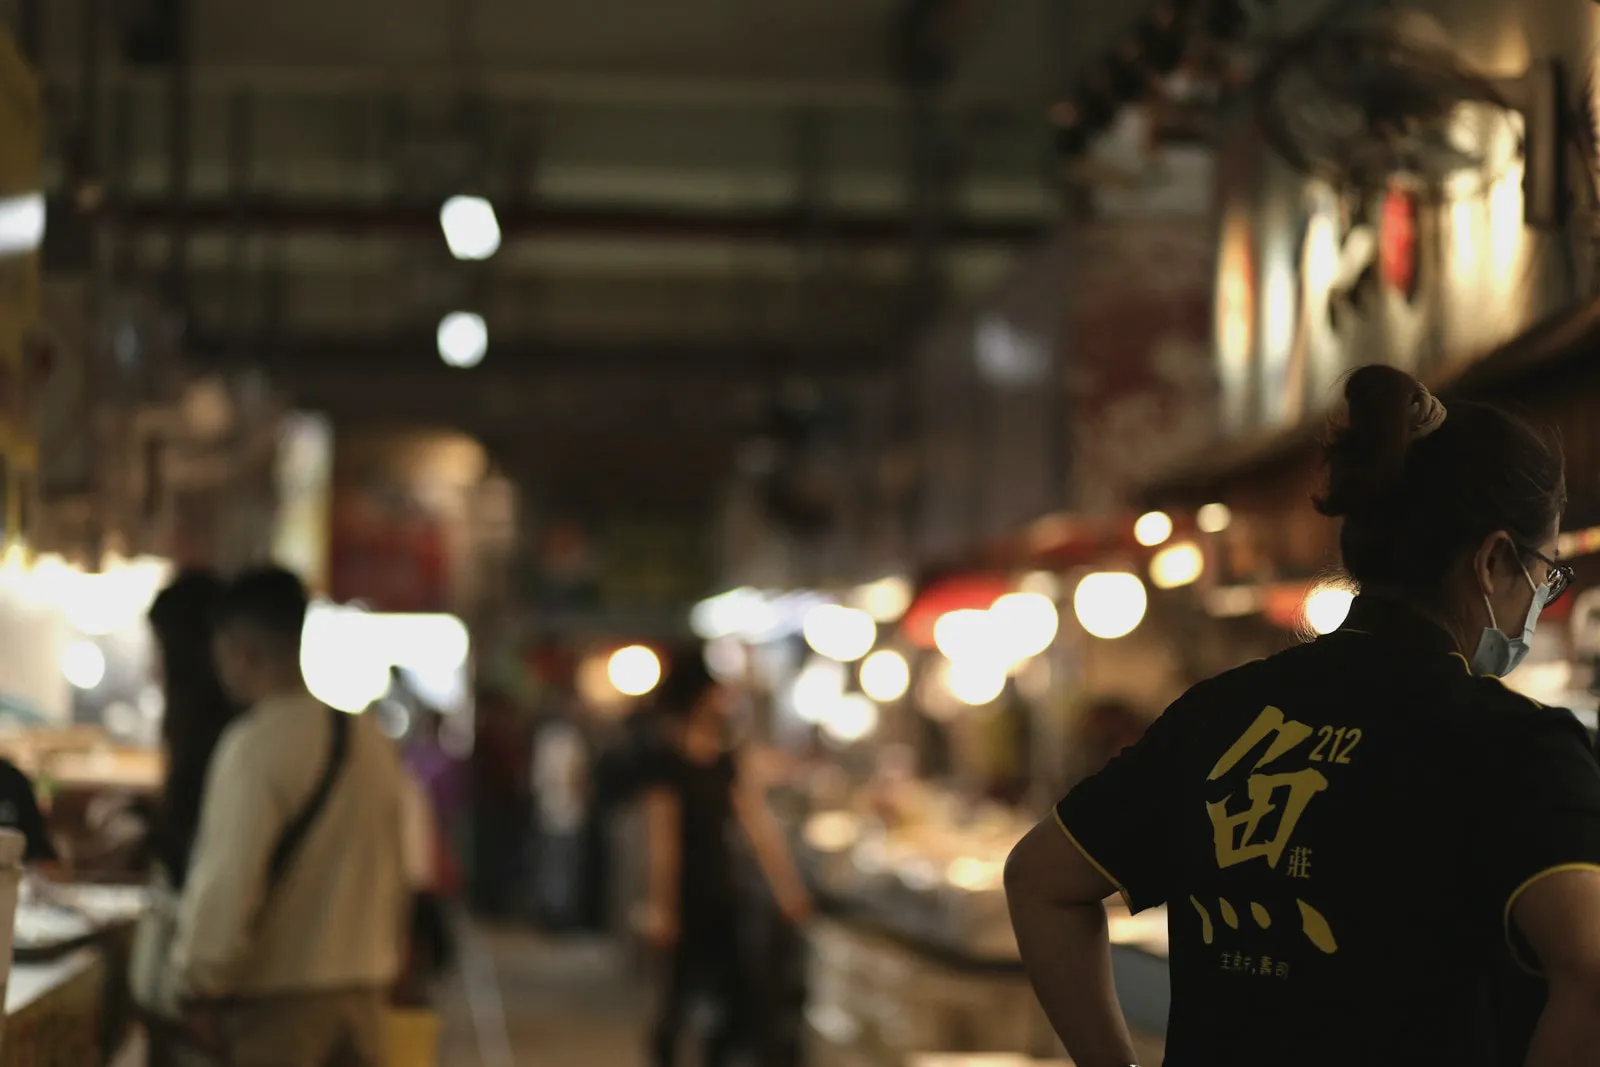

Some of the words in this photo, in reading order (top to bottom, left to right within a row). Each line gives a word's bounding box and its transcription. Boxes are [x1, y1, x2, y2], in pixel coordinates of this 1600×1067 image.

[1309, 725, 1362, 764] 212
[1190, 705, 1338, 954] 魚
[1286, 846, 1312, 878] 莊
